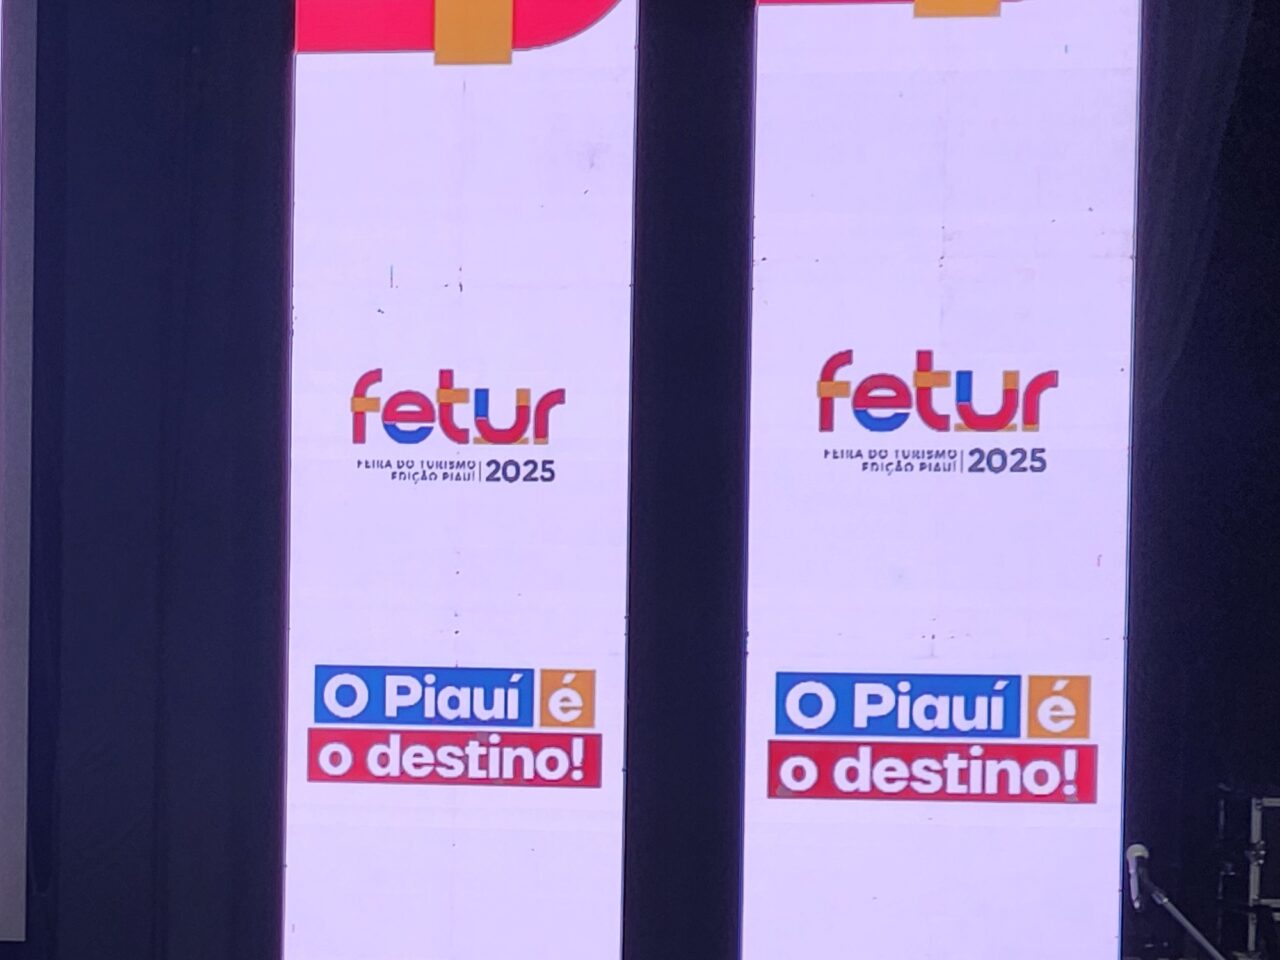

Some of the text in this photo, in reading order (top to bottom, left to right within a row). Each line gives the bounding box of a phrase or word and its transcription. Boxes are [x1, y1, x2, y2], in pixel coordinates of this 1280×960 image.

[350, 368, 566, 444] fetur
[817, 349, 1059, 432] fetur
[420, 460, 476, 469] TURISMO
[485, 459, 555, 483] 2025
[868, 449, 888, 460] DO
[894, 449, 958, 460] TURISMO
[968, 448, 1047, 474] 2025
[323, 673, 584, 722] O Piauí é
[785, 680, 1077, 733] O Piauí é
[318, 733, 585, 781] o destino!
[779, 745, 1078, 796] o destino!
